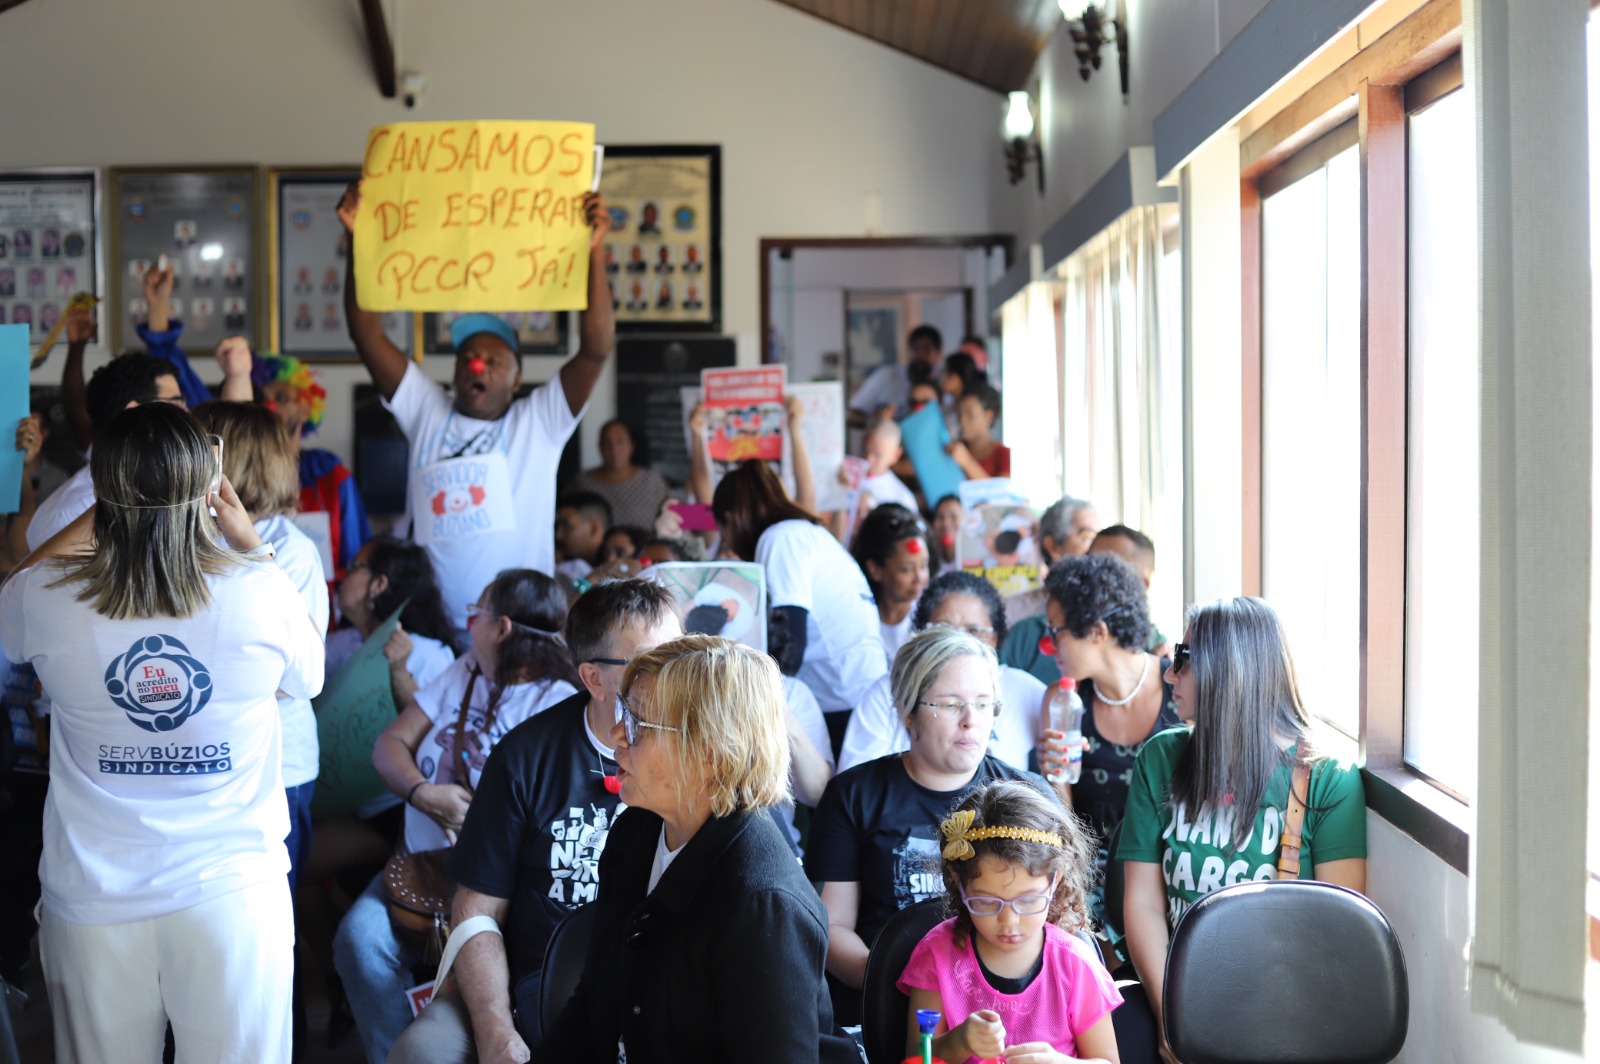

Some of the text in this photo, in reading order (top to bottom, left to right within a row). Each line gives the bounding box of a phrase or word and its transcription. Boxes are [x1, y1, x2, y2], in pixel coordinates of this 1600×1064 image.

[363, 127, 584, 179] CANSAMOS
[374, 186, 587, 242] DE ESPERAR
[376, 250, 495, 301] PCCR
[142, 665, 166, 679] Eu
[136, 677, 178, 688] acredito
[137, 684, 179, 694] no meu
[140, 692, 181, 703] SINDICATO
[98, 742, 231, 760] SERVBÚZIOS
[101, 759, 230, 773] SINDICATO
[1261, 806, 1286, 855] D
[572, 881, 599, 902] M
